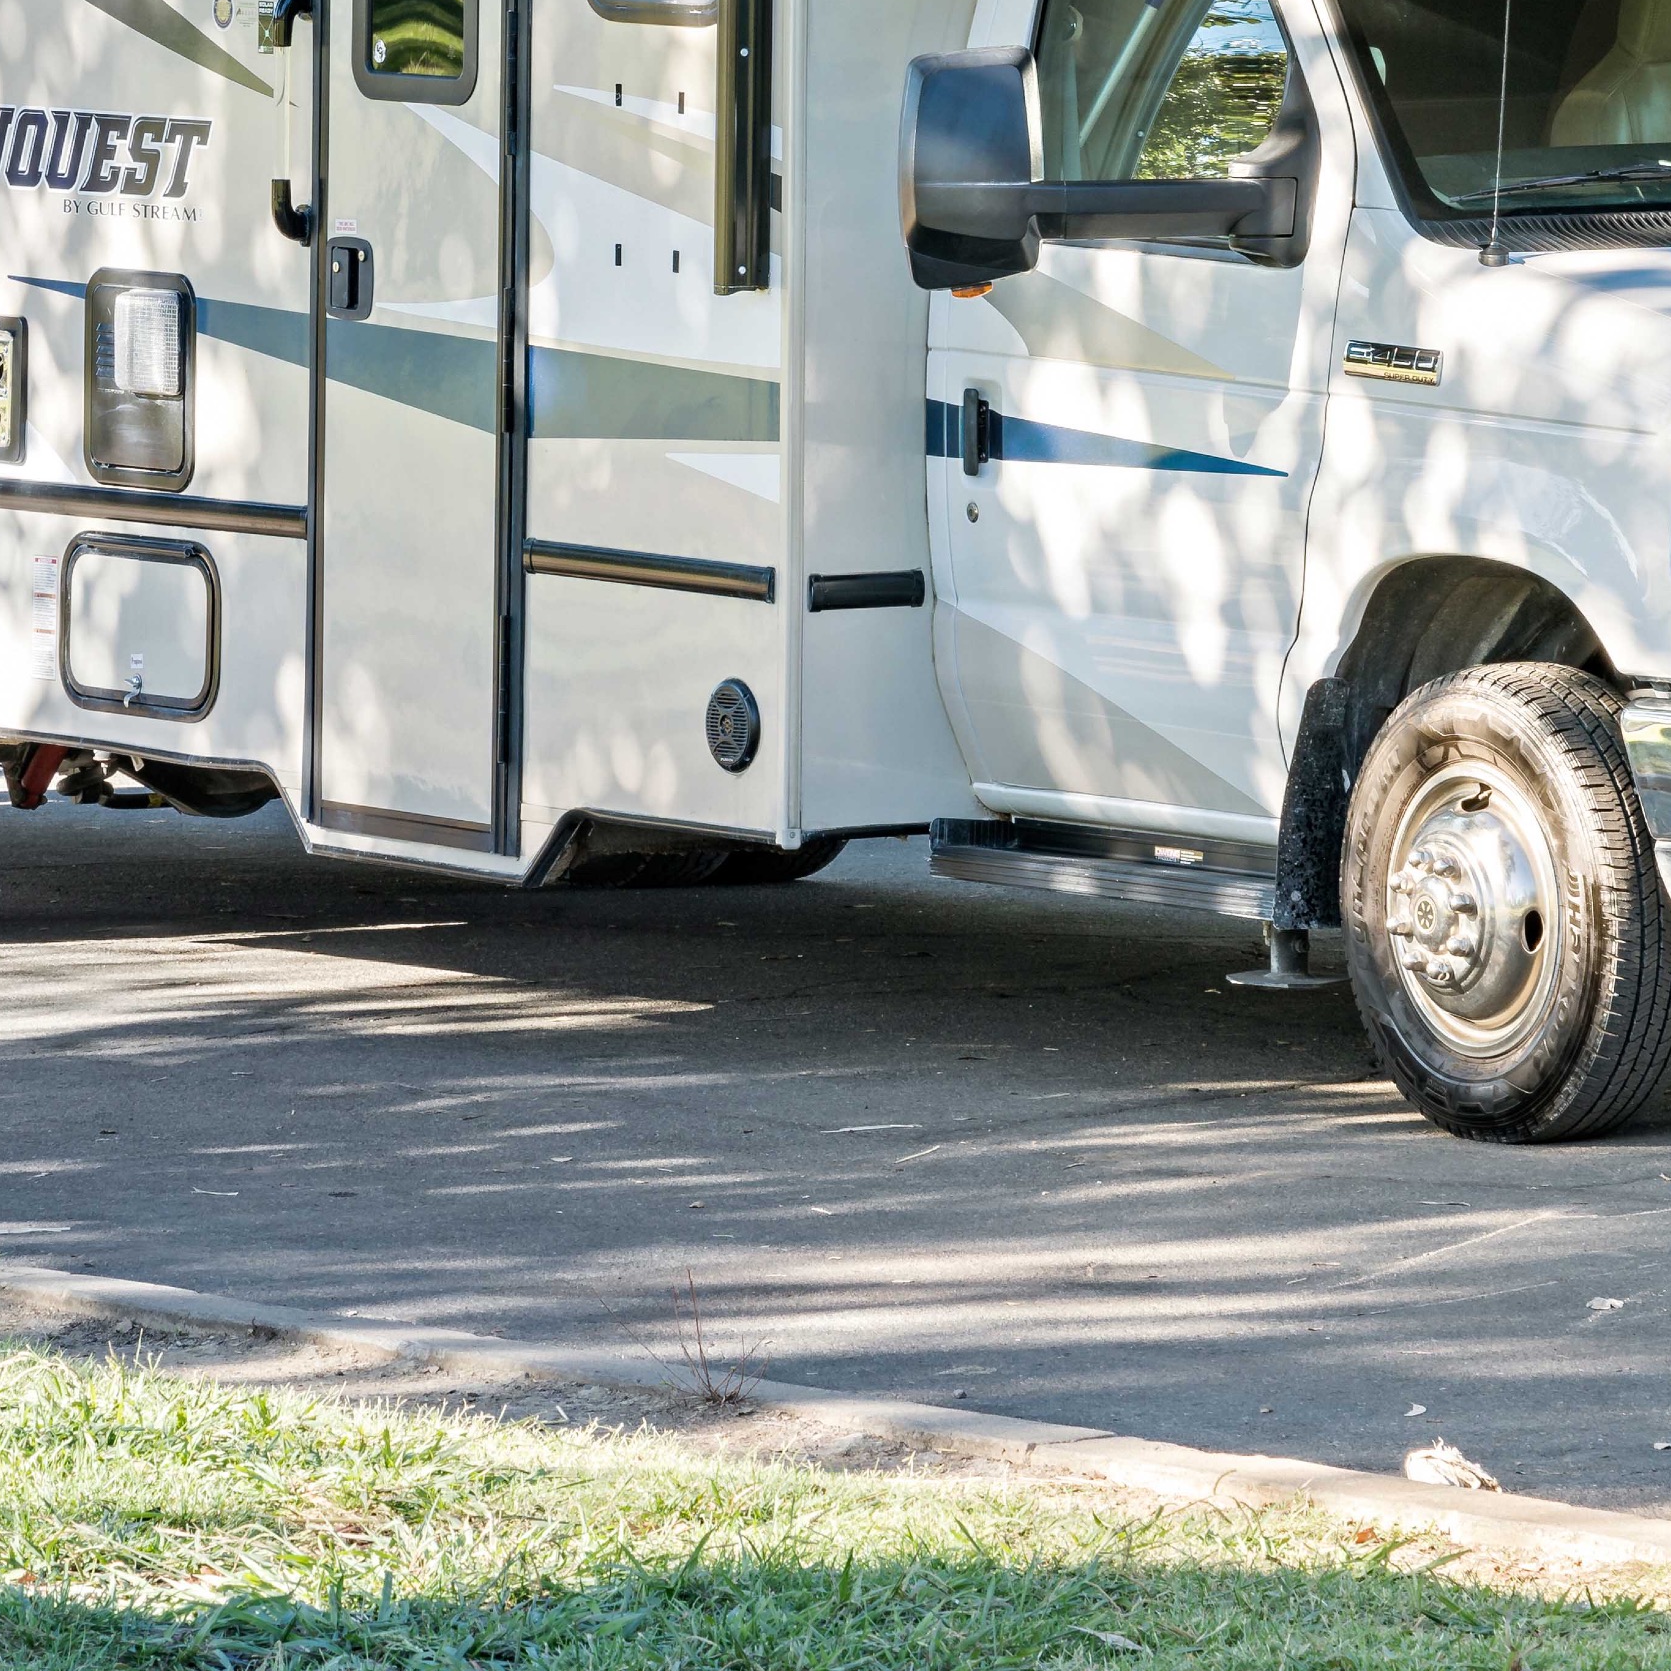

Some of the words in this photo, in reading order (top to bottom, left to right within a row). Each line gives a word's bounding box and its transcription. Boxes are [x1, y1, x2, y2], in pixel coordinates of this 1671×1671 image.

[63, 199, 81, 214] BY
[87, 201, 126, 216] GULF
[132, 203, 196, 222] STREAM
[1384, 372, 1410, 382] SUPER
[1412, 376, 1435, 384] DUTY
